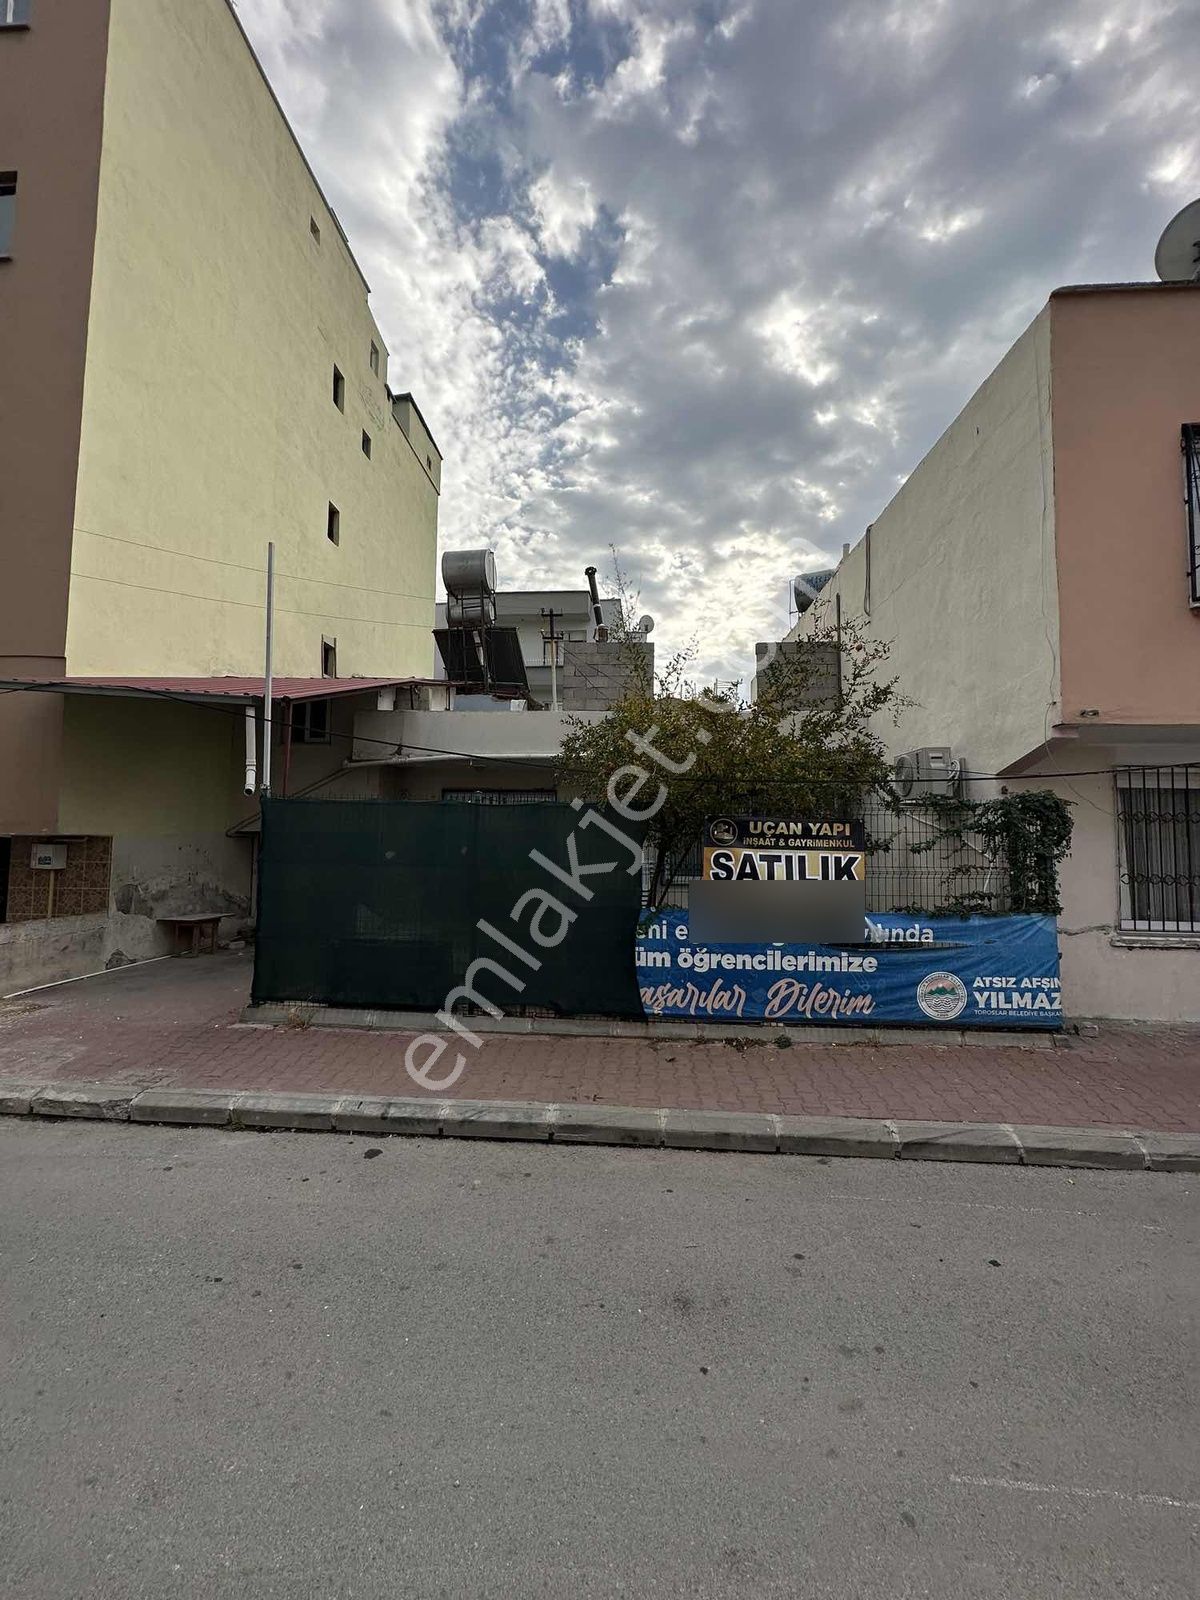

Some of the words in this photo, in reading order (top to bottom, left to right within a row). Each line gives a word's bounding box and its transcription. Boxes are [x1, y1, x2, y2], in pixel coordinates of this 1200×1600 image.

[749, 821, 802, 837] UÇAN
[808, 822, 851, 836] YAPI
[778, 838, 786, 847] &
[709, 850, 862, 880] SATILIK
[635, 946, 671, 968] üm
[677, 947, 878, 973] öğrencilerimize
[973, 976, 1017, 988] ATSIZ
[640, 977, 747, 1018] aşarılar
[764, 977, 876, 1020] Dilerim
[973, 991, 1063, 1010] YILMAZ
